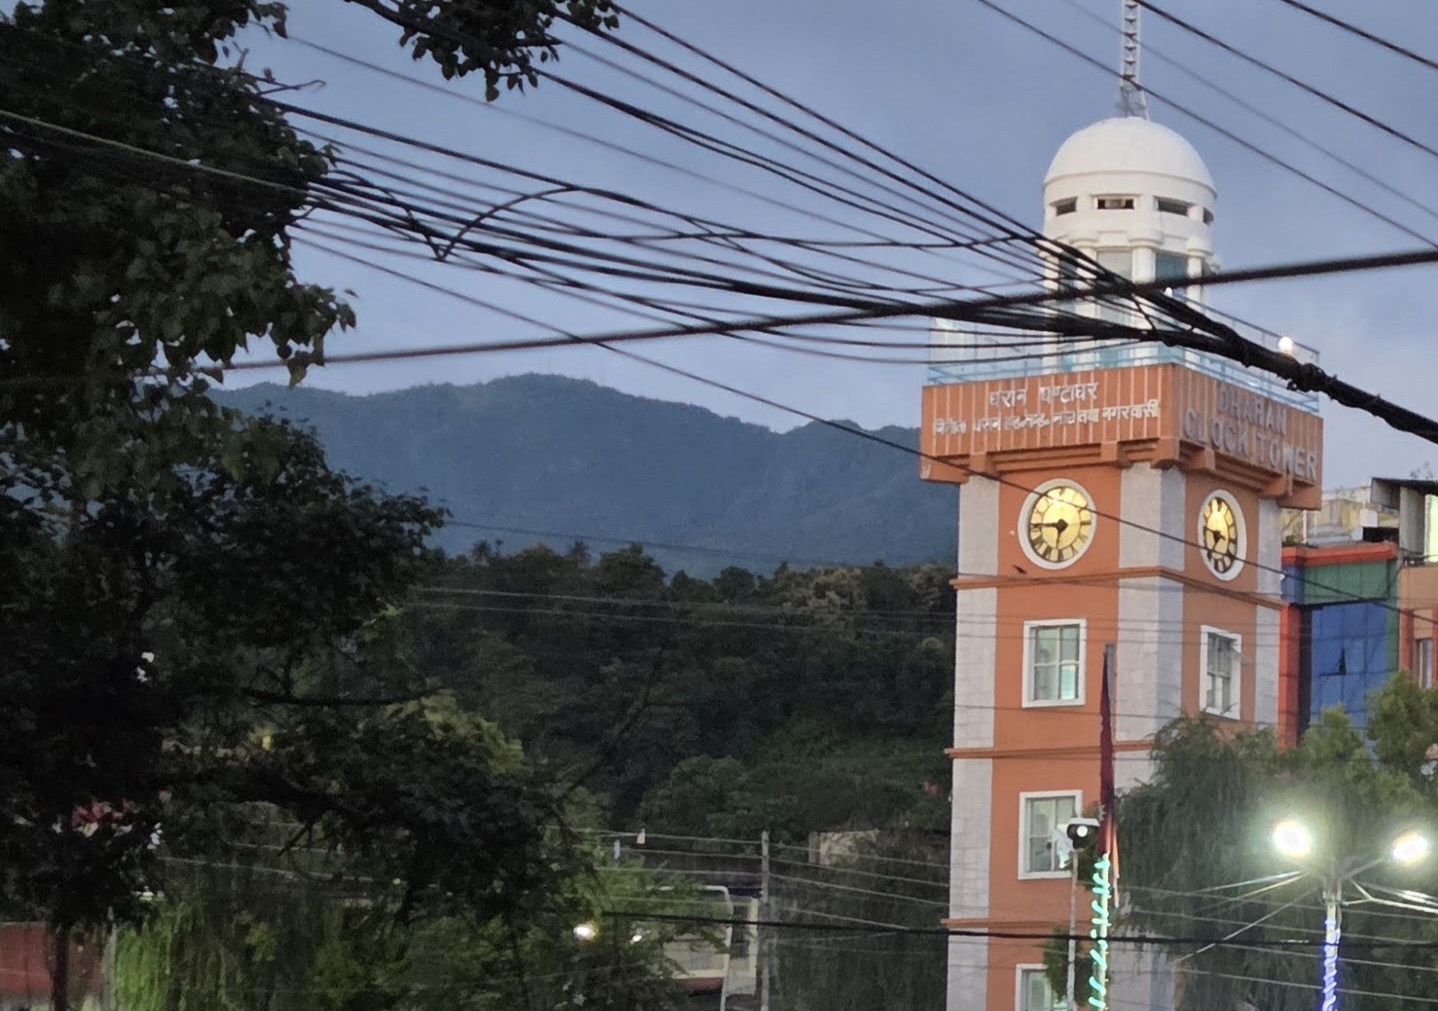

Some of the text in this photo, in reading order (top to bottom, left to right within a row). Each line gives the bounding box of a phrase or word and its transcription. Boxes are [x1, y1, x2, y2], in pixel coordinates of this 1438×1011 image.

[1219, 383, 1287, 437] DHARAN
[1184, 407, 1316, 481] CLOCK TOWER
